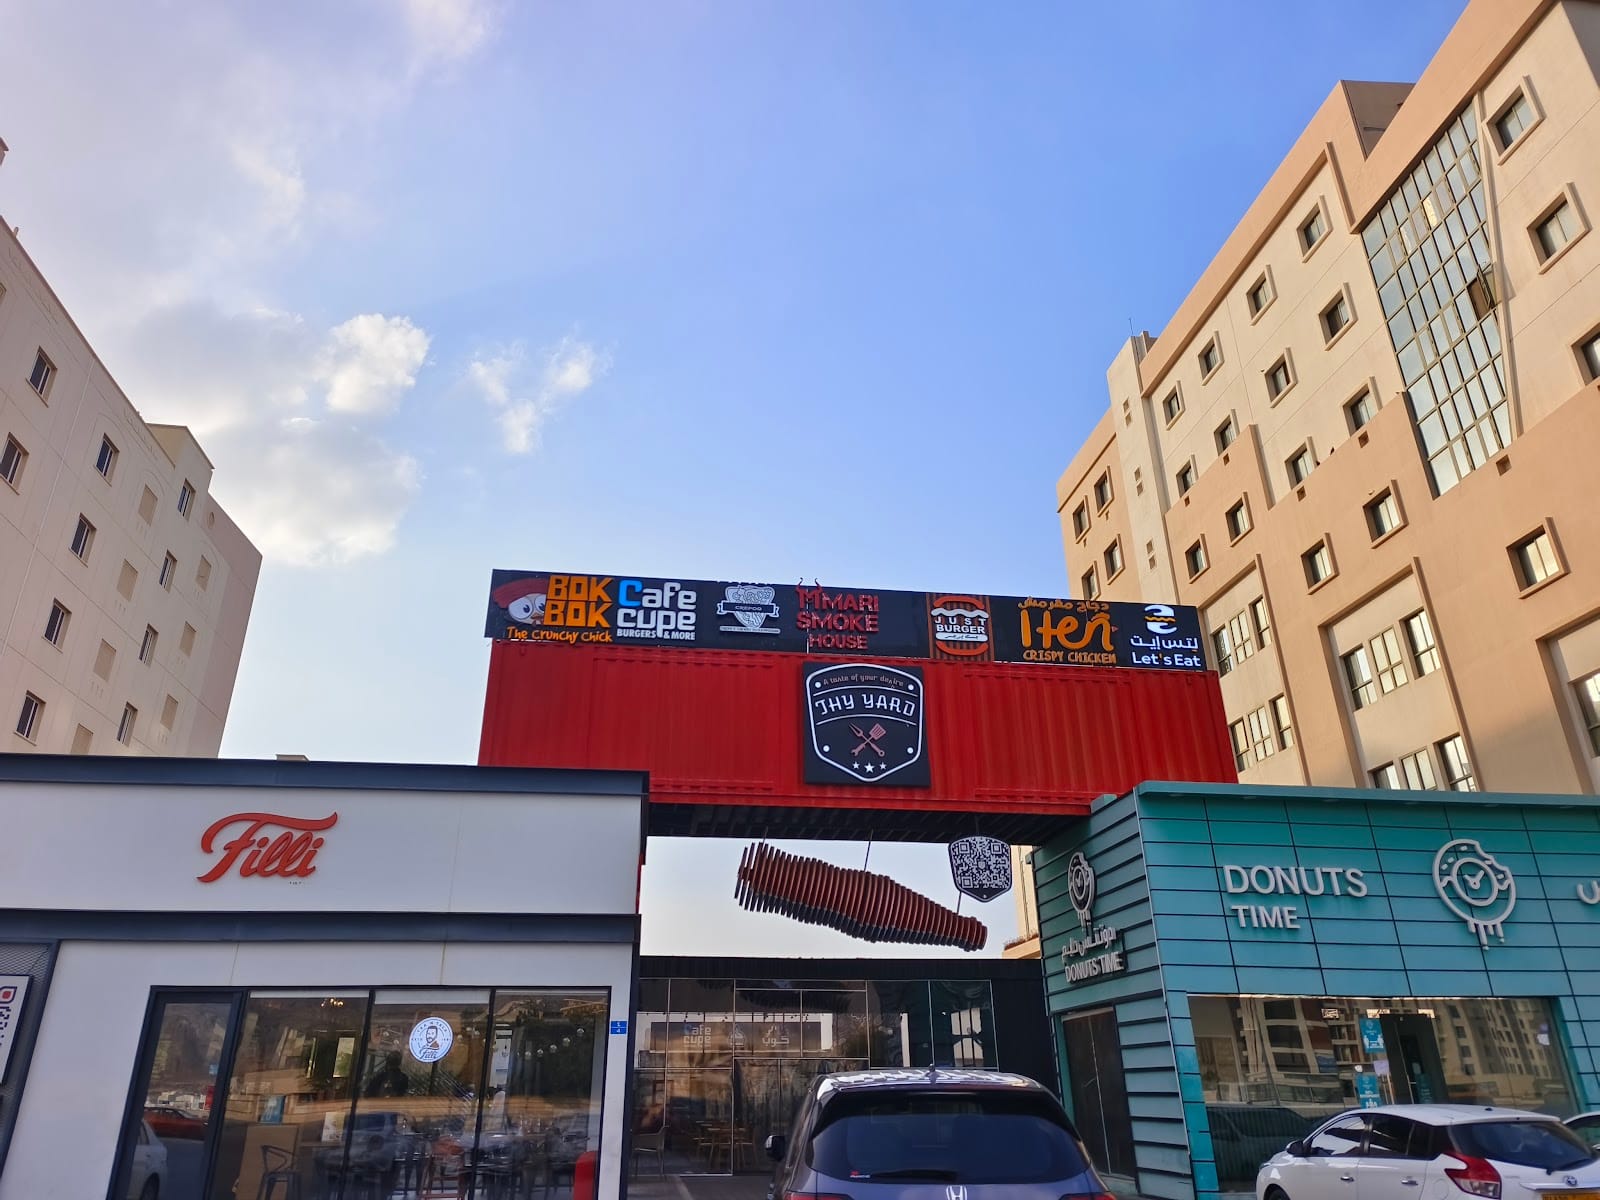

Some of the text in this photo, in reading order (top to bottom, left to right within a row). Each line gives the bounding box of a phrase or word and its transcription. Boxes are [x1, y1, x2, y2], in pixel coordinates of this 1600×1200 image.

[546, 574, 613, 602] BOK
[618, 579, 697, 610] Cafe
[543, 600, 612, 628] BOK
[1017, 597, 1110, 613] دجاج مقرمش
[507, 625, 529, 639] The
[616, 608, 697, 638] cupe
[796, 611, 880, 633] SMOKE
[936, 624, 986, 634] BURGER
[616, 628, 696, 641] BURGERS & MORE
[808, 633, 869, 650] HOUSE
[1022, 649, 1117, 665] CRISPY CHICKEN
[1131, 651, 1202, 667] Let's Eat
[850, 673, 859, 683] of
[859, 675, 878, 683] your
[815, 693, 916, 717] THY YARD
[196, 811, 339, 883] Filli
[1222, 864, 1368, 898] DONUTS
[1231, 905, 1301, 930] TIME
[1064, 951, 1125, 983] DONUTS TIME
